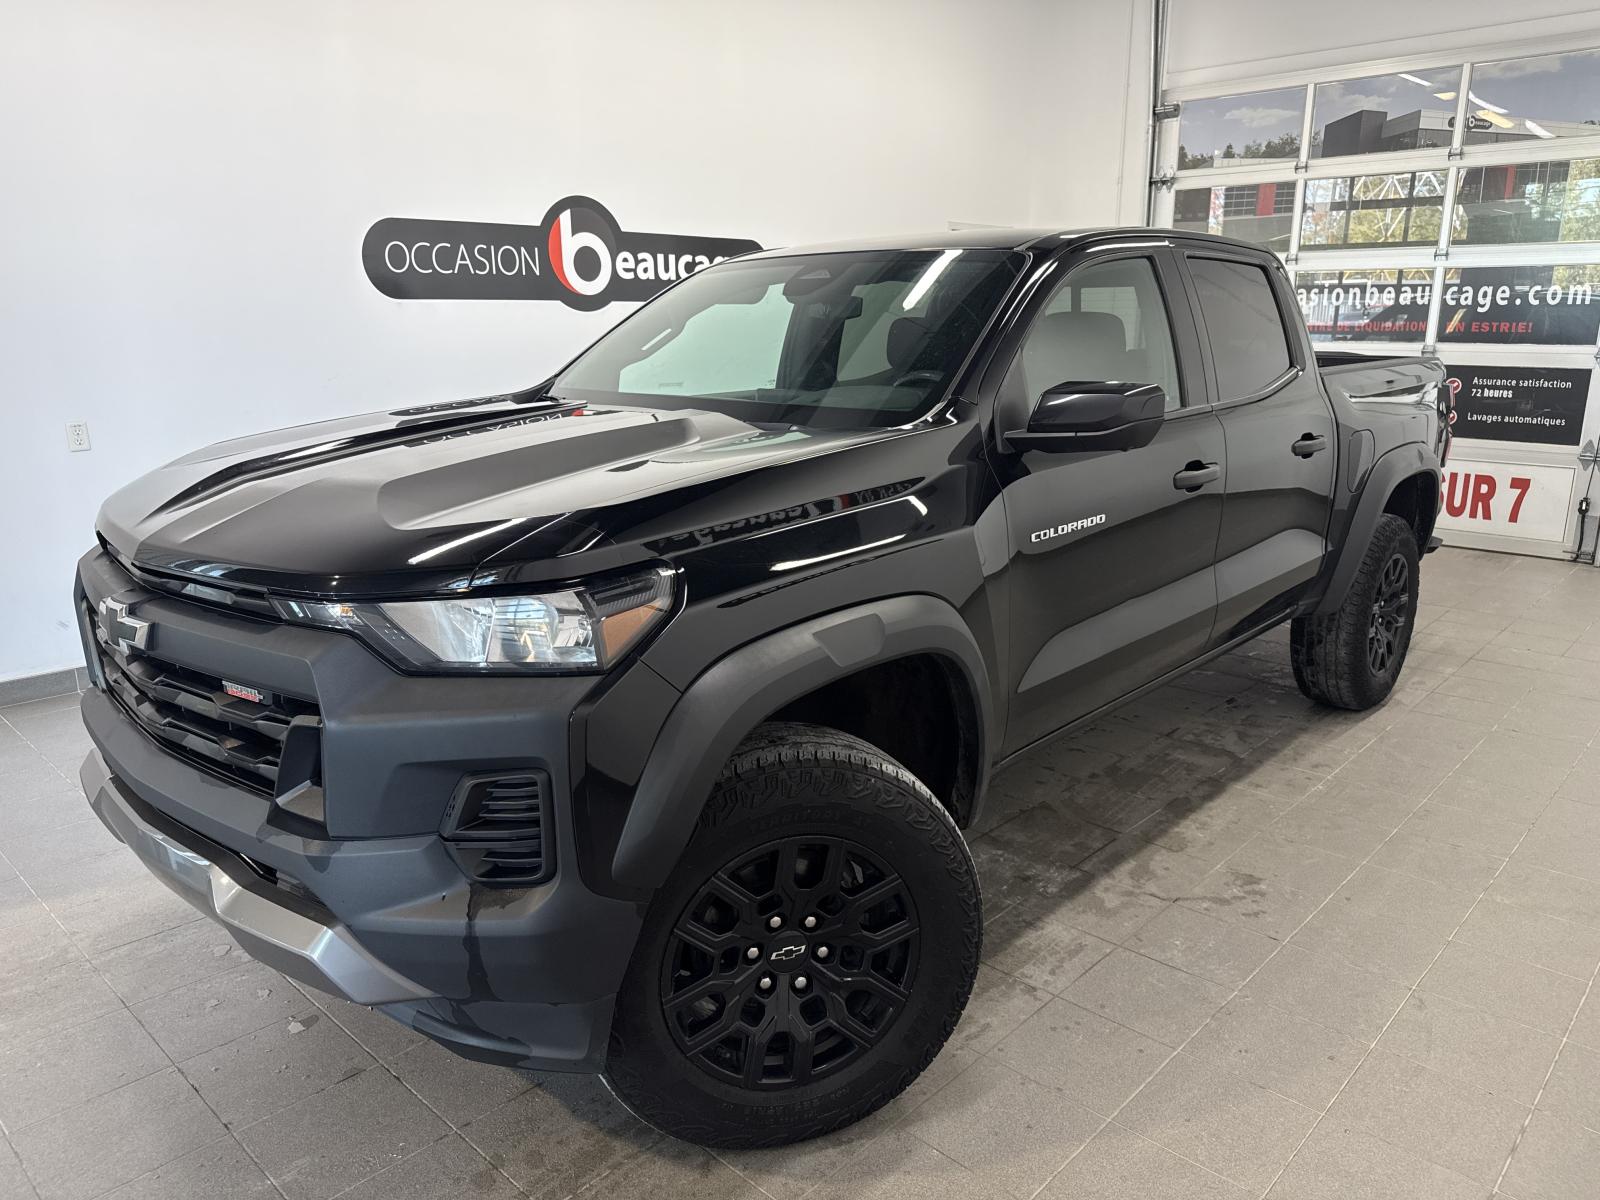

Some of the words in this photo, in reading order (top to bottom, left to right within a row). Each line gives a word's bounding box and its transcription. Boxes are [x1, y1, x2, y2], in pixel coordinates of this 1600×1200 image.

[384, 240, 541, 276] OCCASION
[1336, 322, 1351, 332] DE
[1354, 321, 1428, 333] LIQUIDATION
[1471, 321, 1534, 333] ESTRIE!
[1472, 376, 1517, 387] Assurance
[1519, 379, 1572, 389] satisfaction
[1471, 388, 1482, 397] 72
[1483, 387, 1513, 398] heures
[1467, 412, 1502, 424] Lavages
[1504, 415, 1566, 427] automatiques
[1507, 476, 1532, 524] 7
[1030, 513, 1106, 543] COLORADO
